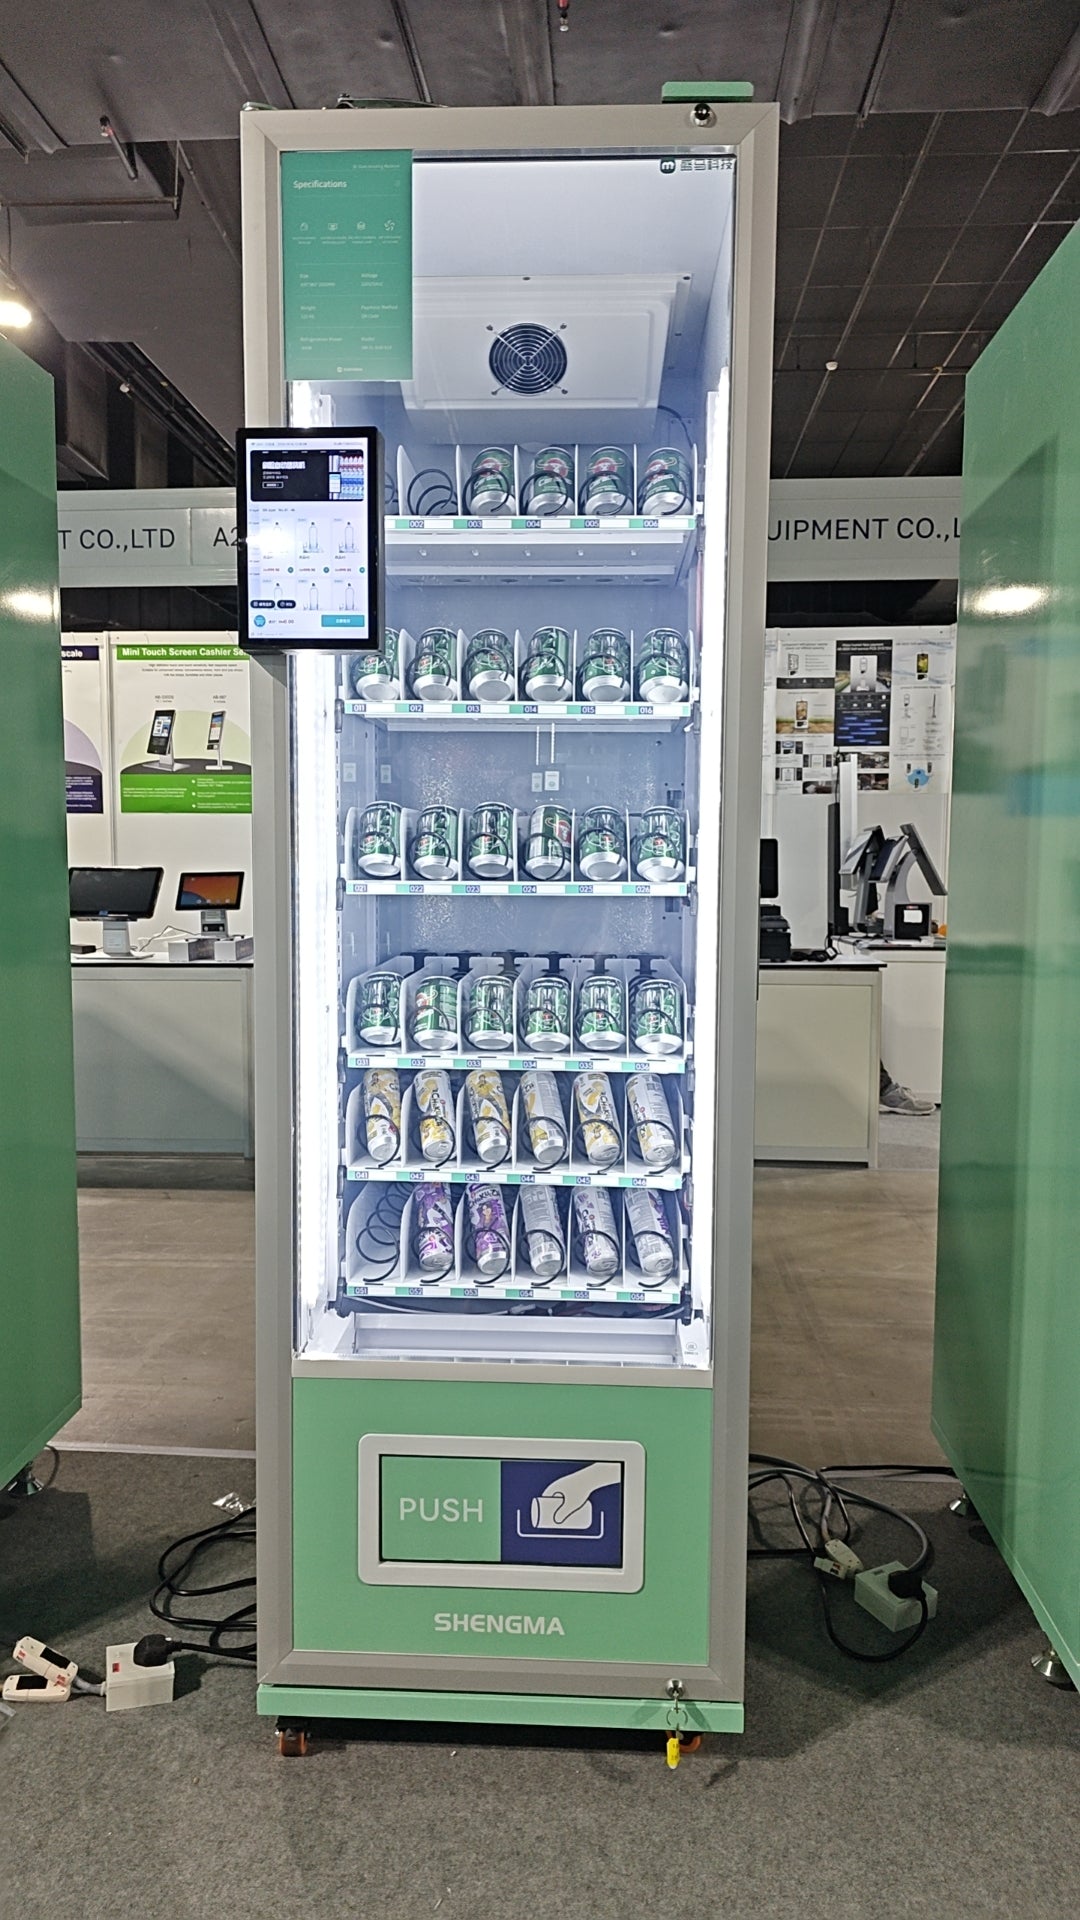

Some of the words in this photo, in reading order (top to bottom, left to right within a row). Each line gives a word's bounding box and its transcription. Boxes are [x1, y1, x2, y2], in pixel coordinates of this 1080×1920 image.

[293, 180, 347, 189] Specifications
[409, 520, 424, 528] 002
[467, 520, 482, 529] 003
[525, 520, 541, 528] 004
[584, 519, 599, 528] 005
[643, 519, 658, 528] 006
[768, 518, 889, 540] UIPMENT
[80, 528, 175, 552] CO.,LTD
[122, 648, 139, 656] Mini
[142, 648, 166, 656] Touch
[169, 648, 197, 656] Screen
[200, 648, 231, 656] Cashier
[352, 704, 366, 712] 011
[409, 704, 423, 712] 012
[466, 705, 480, 713] 013
[523, 705, 538, 714] 014
[581, 706, 595, 714] 015
[639, 706, 653, 714] 016
[579, 885, 593, 893] 025
[356, 1058, 370, 1066] 031
[467, 1060, 481, 1068] 033
[635, 1062, 649, 1070] 036
[410, 1172, 424, 1180] 042
[576, 1176, 590, 1184] 045
[354, 1287, 368, 1295] 051
[519, 1290, 533, 1298] 054
[575, 1291, 589, 1299] 055
[630, 1292, 645, 1300] 056
[400, 1498, 484, 1522] PUSH
[434, 1612, 565, 1636] SHENGMA
